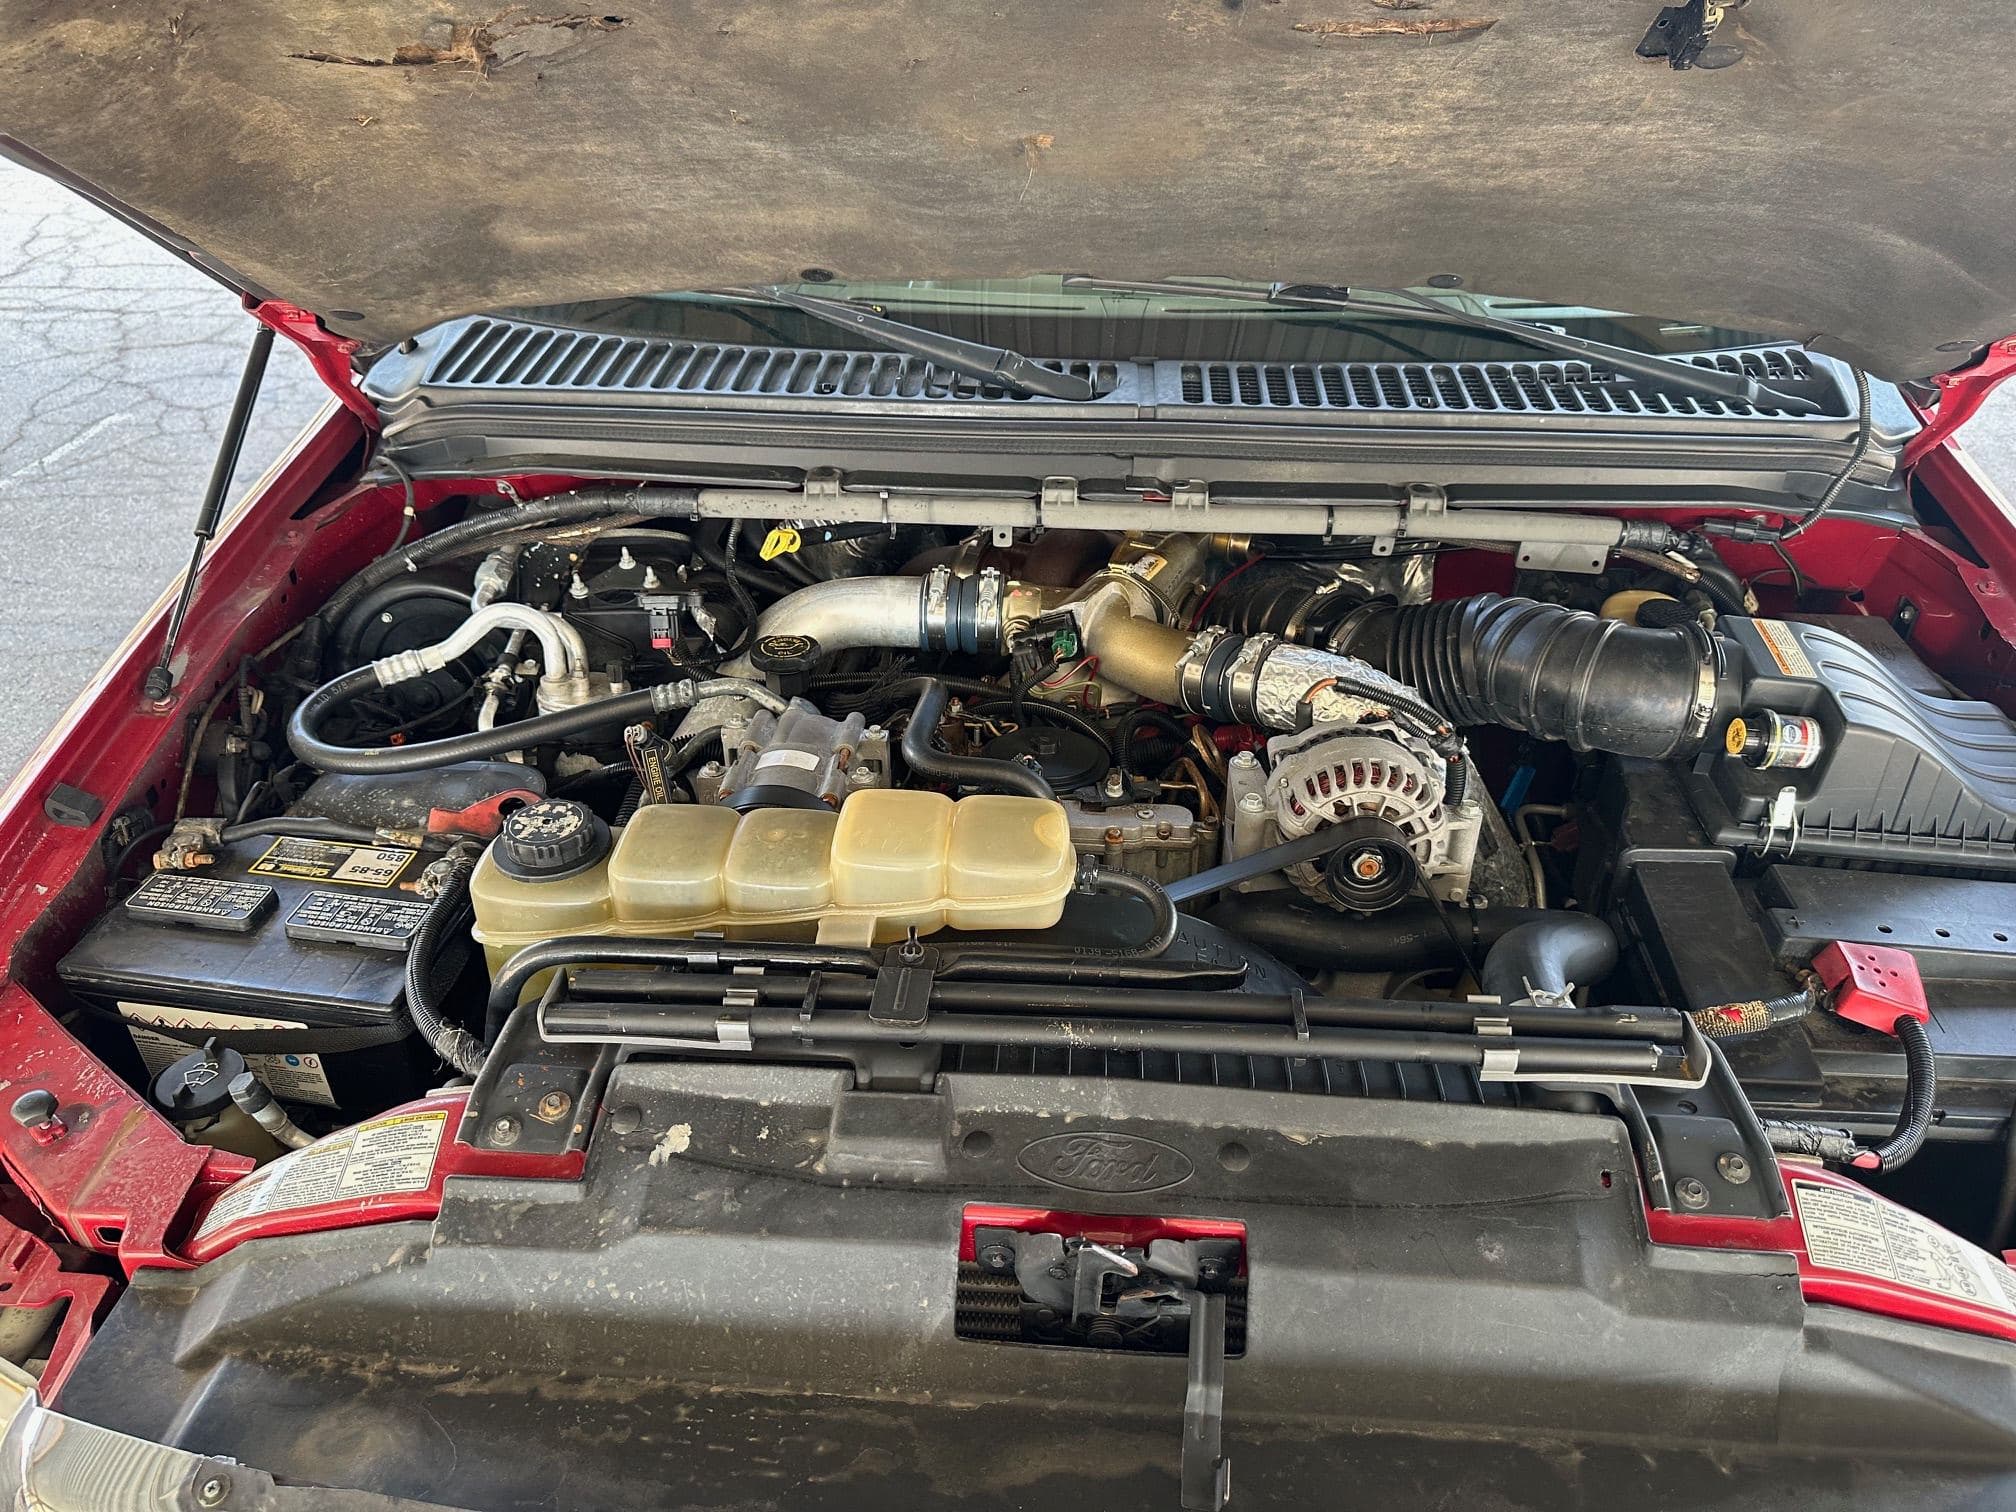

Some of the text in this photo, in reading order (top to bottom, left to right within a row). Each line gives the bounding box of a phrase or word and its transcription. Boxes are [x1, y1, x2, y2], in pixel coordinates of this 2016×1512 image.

[647, 756, 665, 800] ENGINE OIL
[349, 865, 394, 877] 65-85
[376, 852, 407, 863] 850
[1051, 1136, 1160, 1184] Ford
